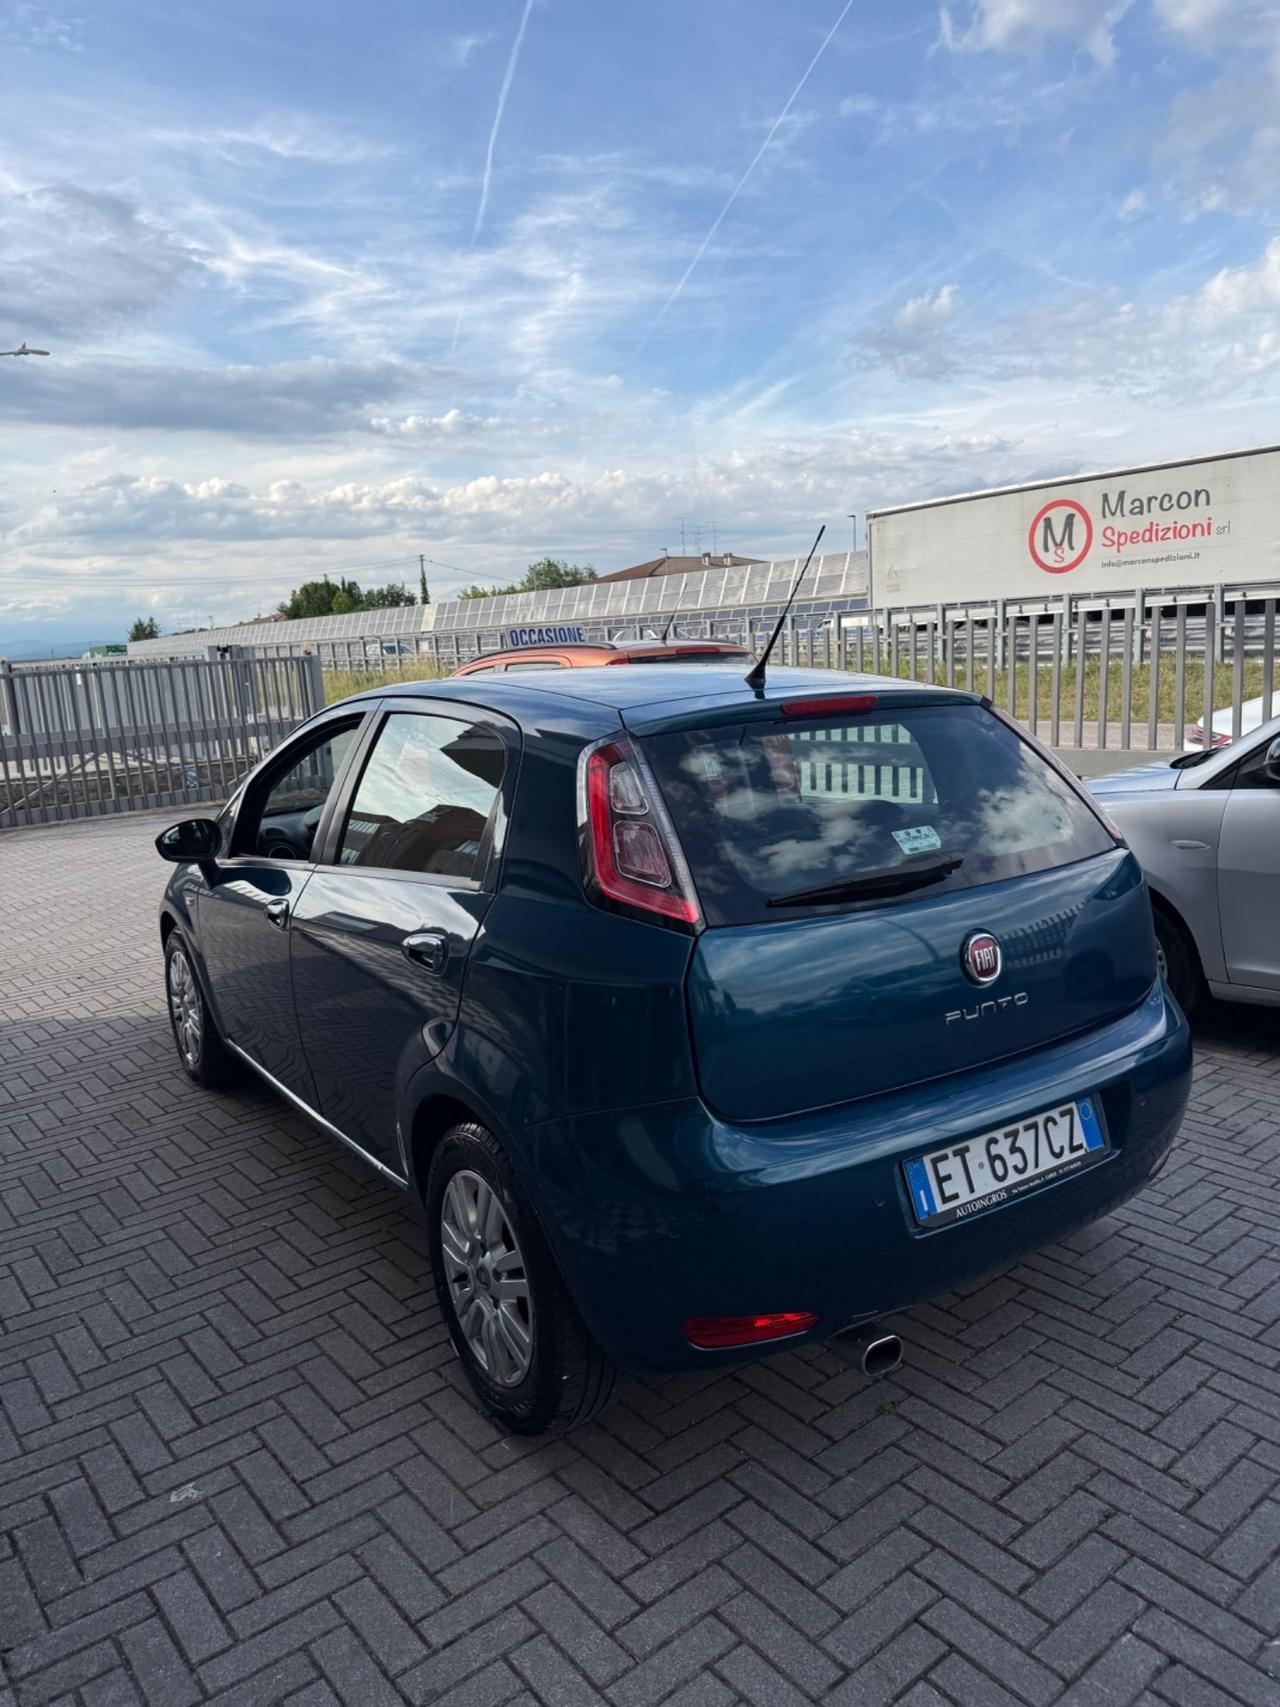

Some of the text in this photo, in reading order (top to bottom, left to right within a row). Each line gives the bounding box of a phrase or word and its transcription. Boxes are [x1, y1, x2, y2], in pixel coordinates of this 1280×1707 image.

[1101, 488, 1211, 519] Marcon
[1101, 517, 1231, 553] Spedizioni srl
[1101, 552, 1200, 569] info@marconspedizioni.it
[510, 627, 585, 646] OCCASIONE
[974, 946, 996, 971] FIAT
[945, 992, 1028, 1026] PUNTO
[955, 1190, 1008, 1219] AUTOINGROS
